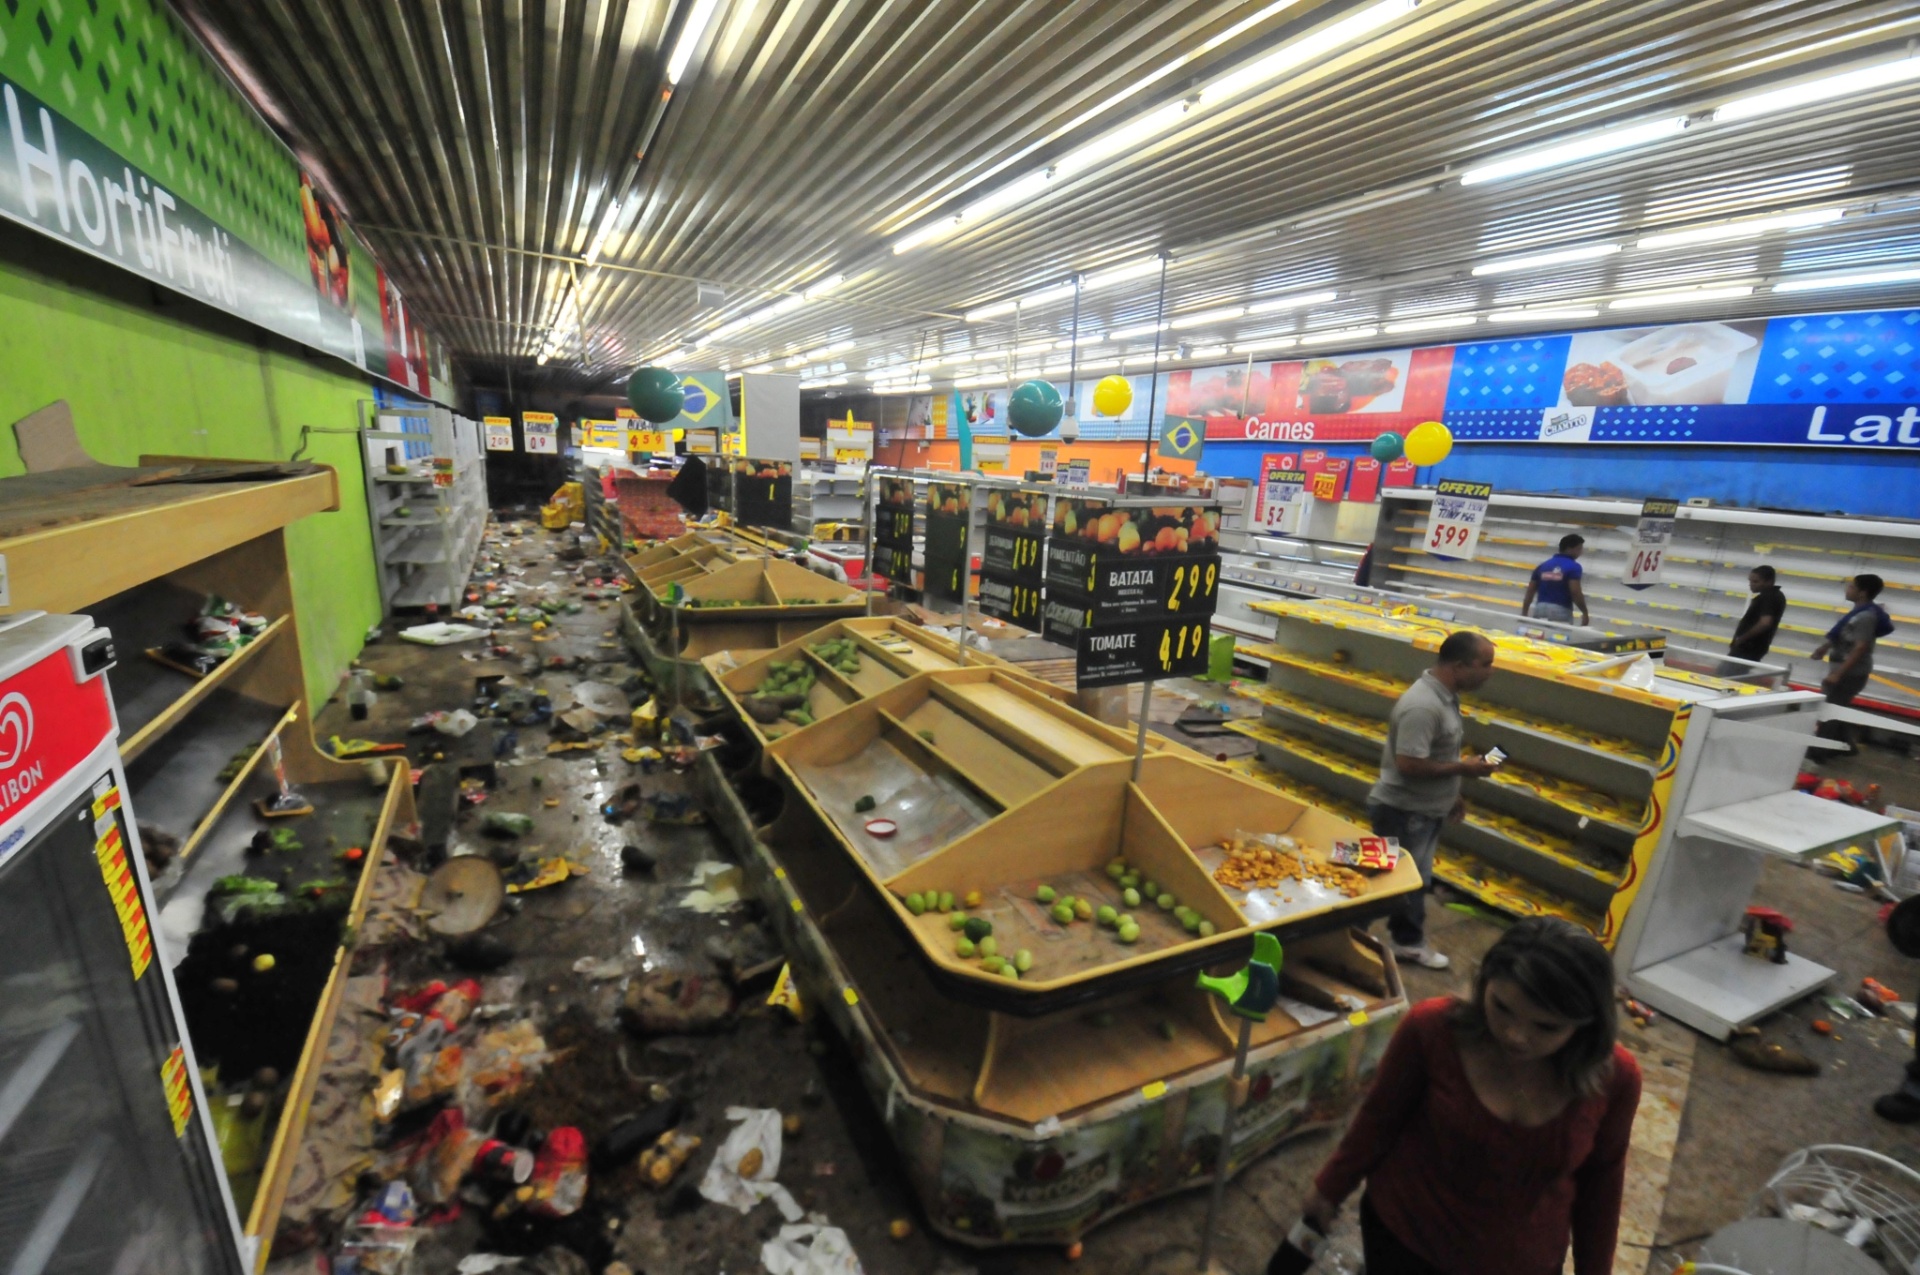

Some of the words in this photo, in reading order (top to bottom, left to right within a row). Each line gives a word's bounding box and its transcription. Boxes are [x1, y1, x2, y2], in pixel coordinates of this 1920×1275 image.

[4, 83, 239, 307] HortiFruti
[1245, 417, 1315, 440] Carnes
[1544, 414, 1587, 437] CHAMYTO
[1807, 405, 1920, 444] Lat
[1269, 471, 1305, 482] OFERTA
[1439, 482, 1491, 496] OFERTA
[1643, 501, 1676, 514] OFERTA
[1050, 547, 1086, 567] PIMENTÃO
[1109, 570, 1154, 587] BATATA
[1090, 634, 1136, 652] TOMATE
[0, 759, 43, 813] IBON
